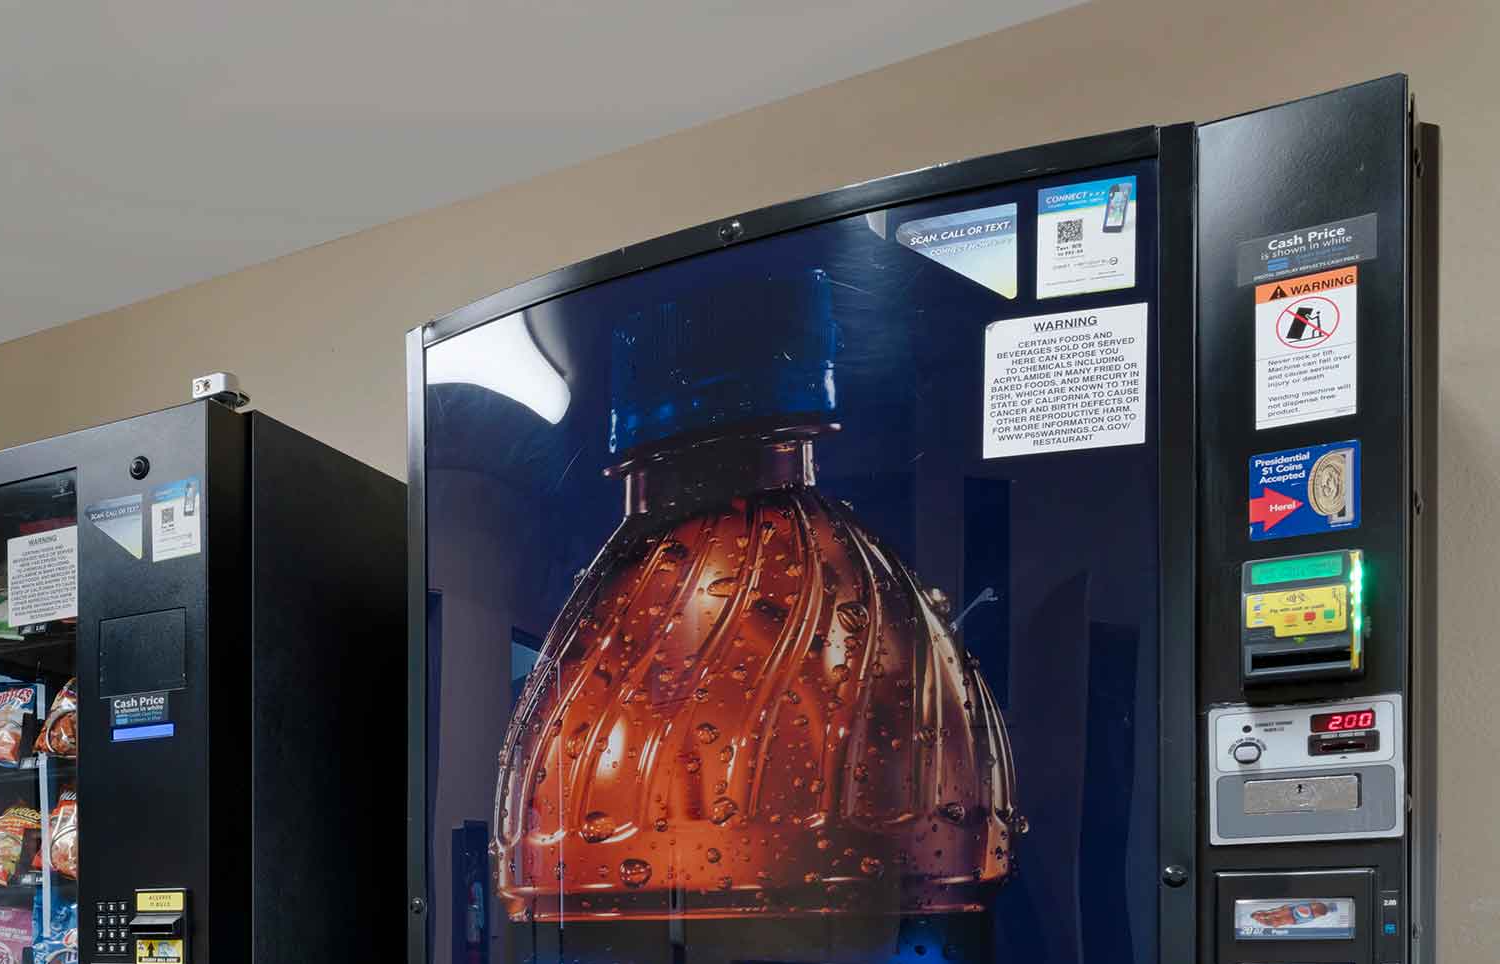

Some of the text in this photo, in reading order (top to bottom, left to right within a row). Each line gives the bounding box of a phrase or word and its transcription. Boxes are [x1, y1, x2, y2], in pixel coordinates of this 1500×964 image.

[1046, 192, 1088, 204] CONNECT
[941, 229, 965, 240] CALL
[967, 227, 982, 235] OR
[985, 221, 1011, 232] TEXT.
[1268, 227, 1345, 250] Cash Price
[1272, 246, 1306, 257] shown
[1323, 235, 1352, 247] white
[1291, 274, 1354, 295] WARNING
[1034, 315, 1098, 332] WARNING
[997, 337, 1135, 359] BEVERAGES SOLD OR SERVED
[1018, 331, 1113, 348] CERTAIN FOODS AND
[1006, 355, 1124, 375] TO CHEMICALS INCLUDING
[1012, 357, 1036, 366] HERE
[1038, 355, 1057, 363] CAN
[1060, 349, 1096, 360] EXPOSE
[1268, 358, 1290, 366] Never
[993, 371, 1050, 384] ACRYLAMIDE
[1054, 369, 1063, 377] IN
[1065, 367, 1091, 376] MANY
[1094, 365, 1121, 374] FRIED
[1268, 363, 1300, 373] Machine
[1284, 369, 1308, 378] cause
[1310, 364, 1339, 373] serious
[991, 384, 1022, 393] BAKED
[1082, 372, 1128, 382] MERCURY
[1016, 389, 1045, 399] WHICH
[1068, 383, 1103, 393] KNOWN
[1268, 380, 1289, 388] injury
[991, 401, 1018, 409] STATE
[1035, 393, 1089, 404] CALIFORNIA
[1107, 387, 1139, 397] CAUSE
[1268, 393, 1300, 402] Vending
[1302, 387, 1335, 396] machine
[1283, 397, 1318, 407] dispense
[990, 408, 1027, 418] CANCER
[1030, 406, 1049, 414] AND
[1051, 402, 1078, 411] BIRTH
[1081, 397, 1123, 408] DEFECTS
[992, 426, 1011, 434] FOR
[1014, 423, 1039, 432] MORE
[1042, 416, 1104, 429] INFORMATION
[1107, 415, 1121, 423] GO
[996, 416, 1027, 425] OTHER
[1029, 408, 1100, 422] REPRODUCTIVE
[1033, 434, 1093, 446] RESTAURANT
[1255, 451, 1310, 468] Presidential
[1259, 470, 1305, 484] Accepted
[1262, 463, 1303, 475] $1 Coins
[1269, 500, 1296, 512] Here!
[114, 696, 164, 708] Cash Price
